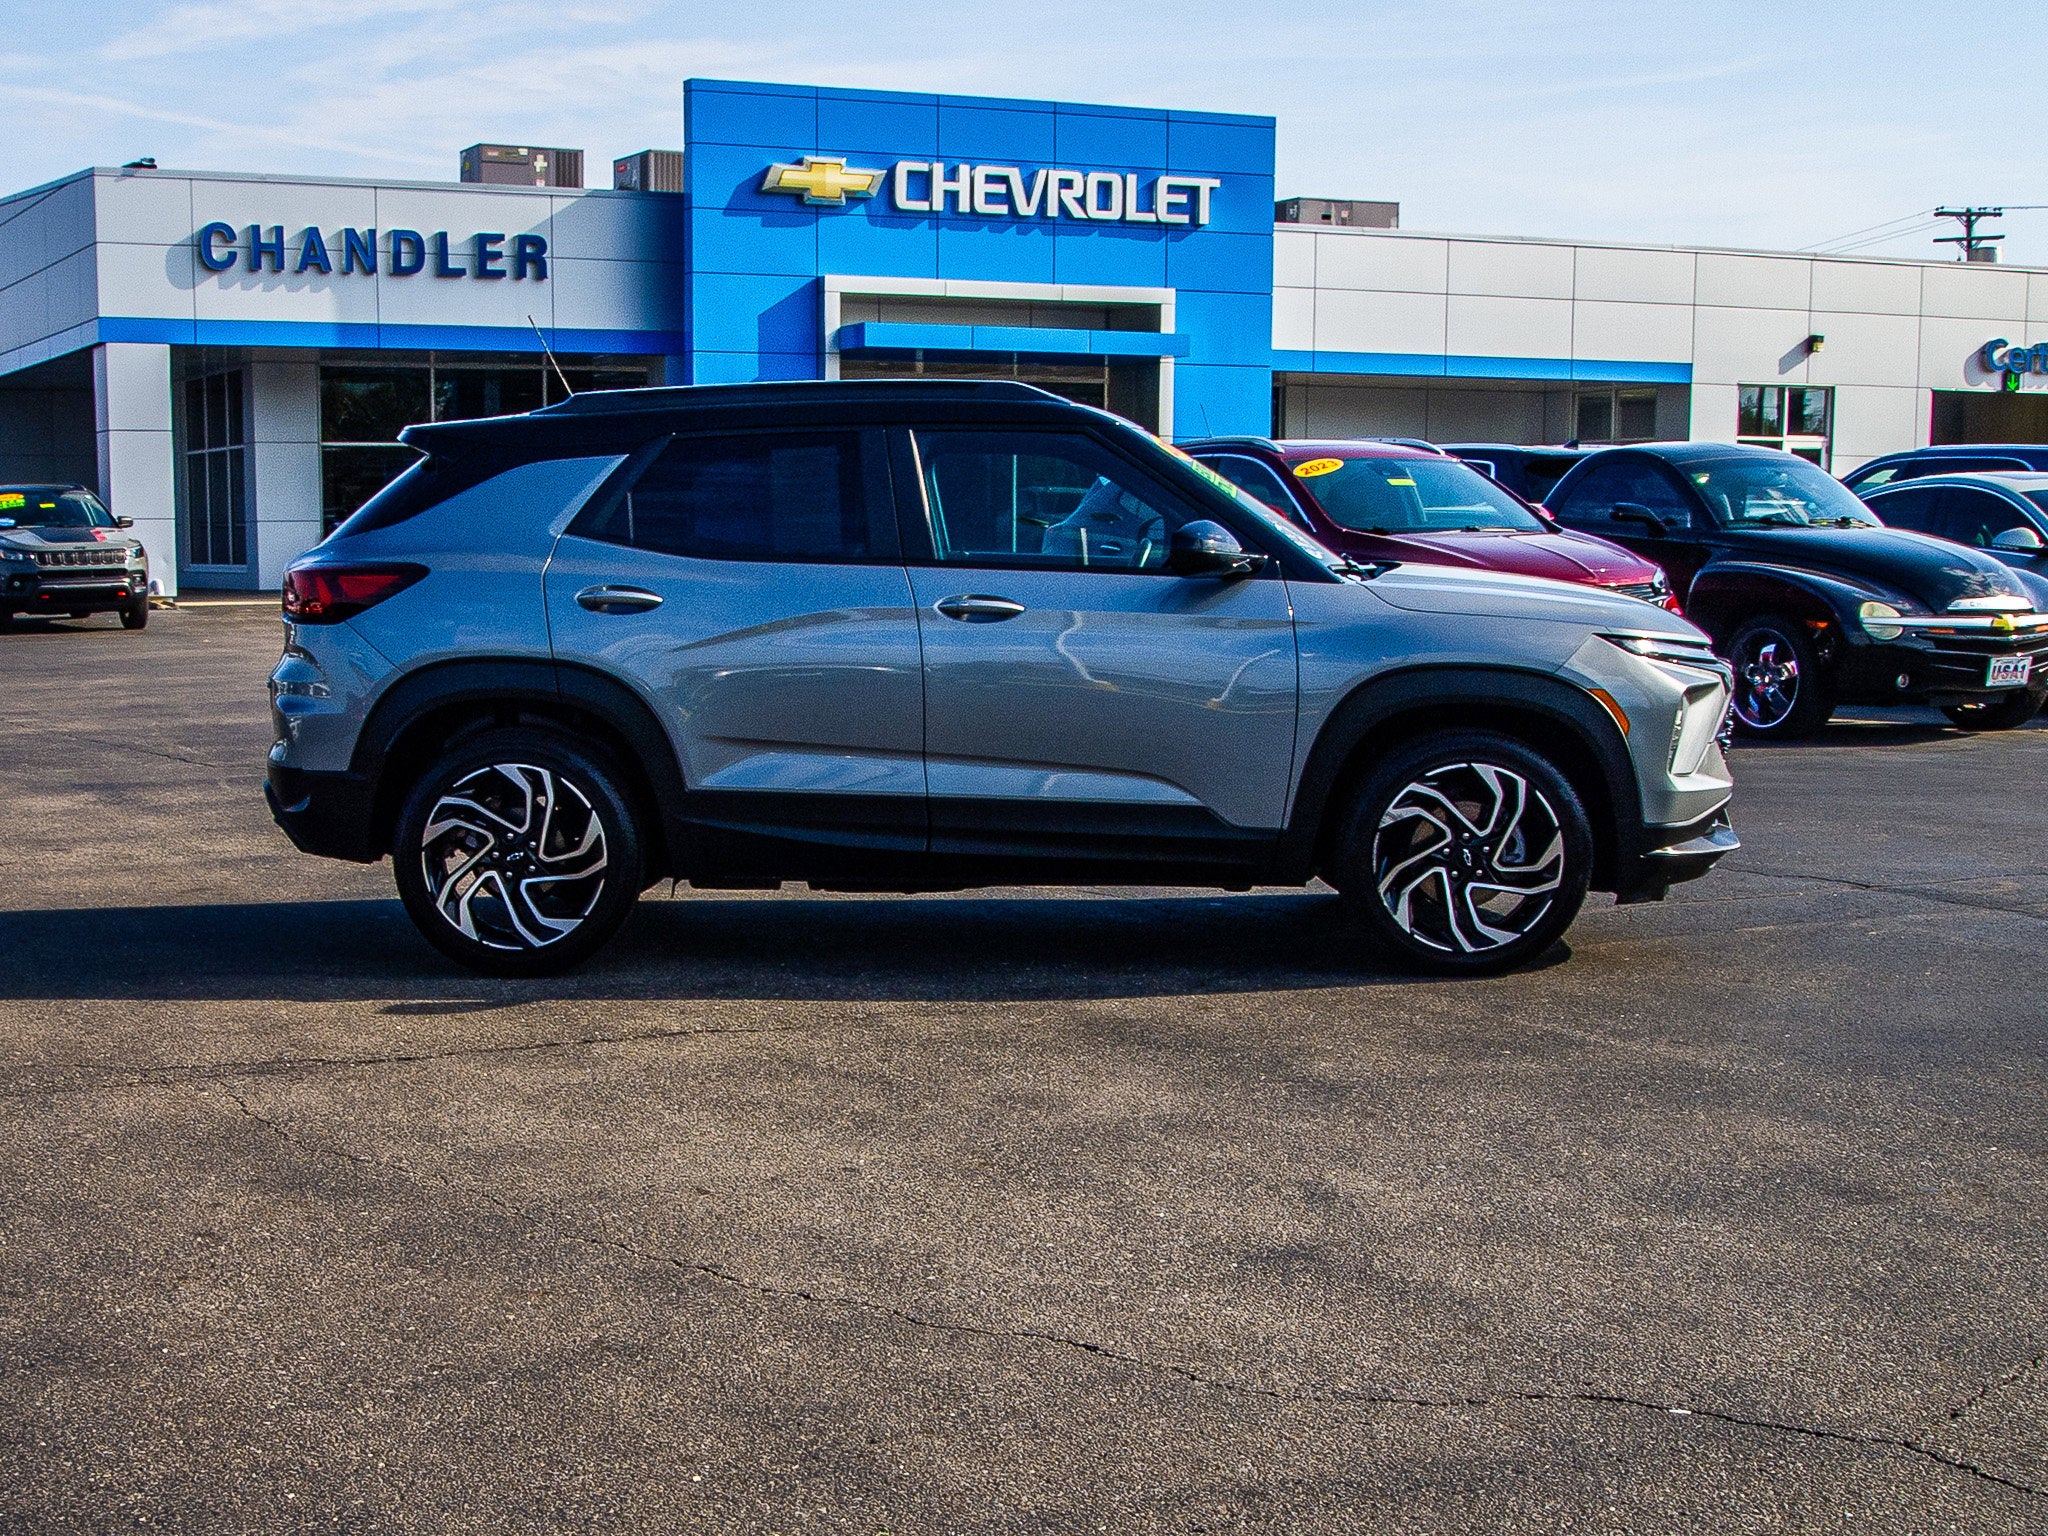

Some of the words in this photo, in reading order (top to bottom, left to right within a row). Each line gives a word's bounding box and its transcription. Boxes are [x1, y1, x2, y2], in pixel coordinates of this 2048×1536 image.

[894, 160, 1221, 225] CHEVROLET
[199, 221, 549, 280] CHANDLER
[1300, 460, 1338, 476] 2023
[1990, 663, 2027, 681] USA1
